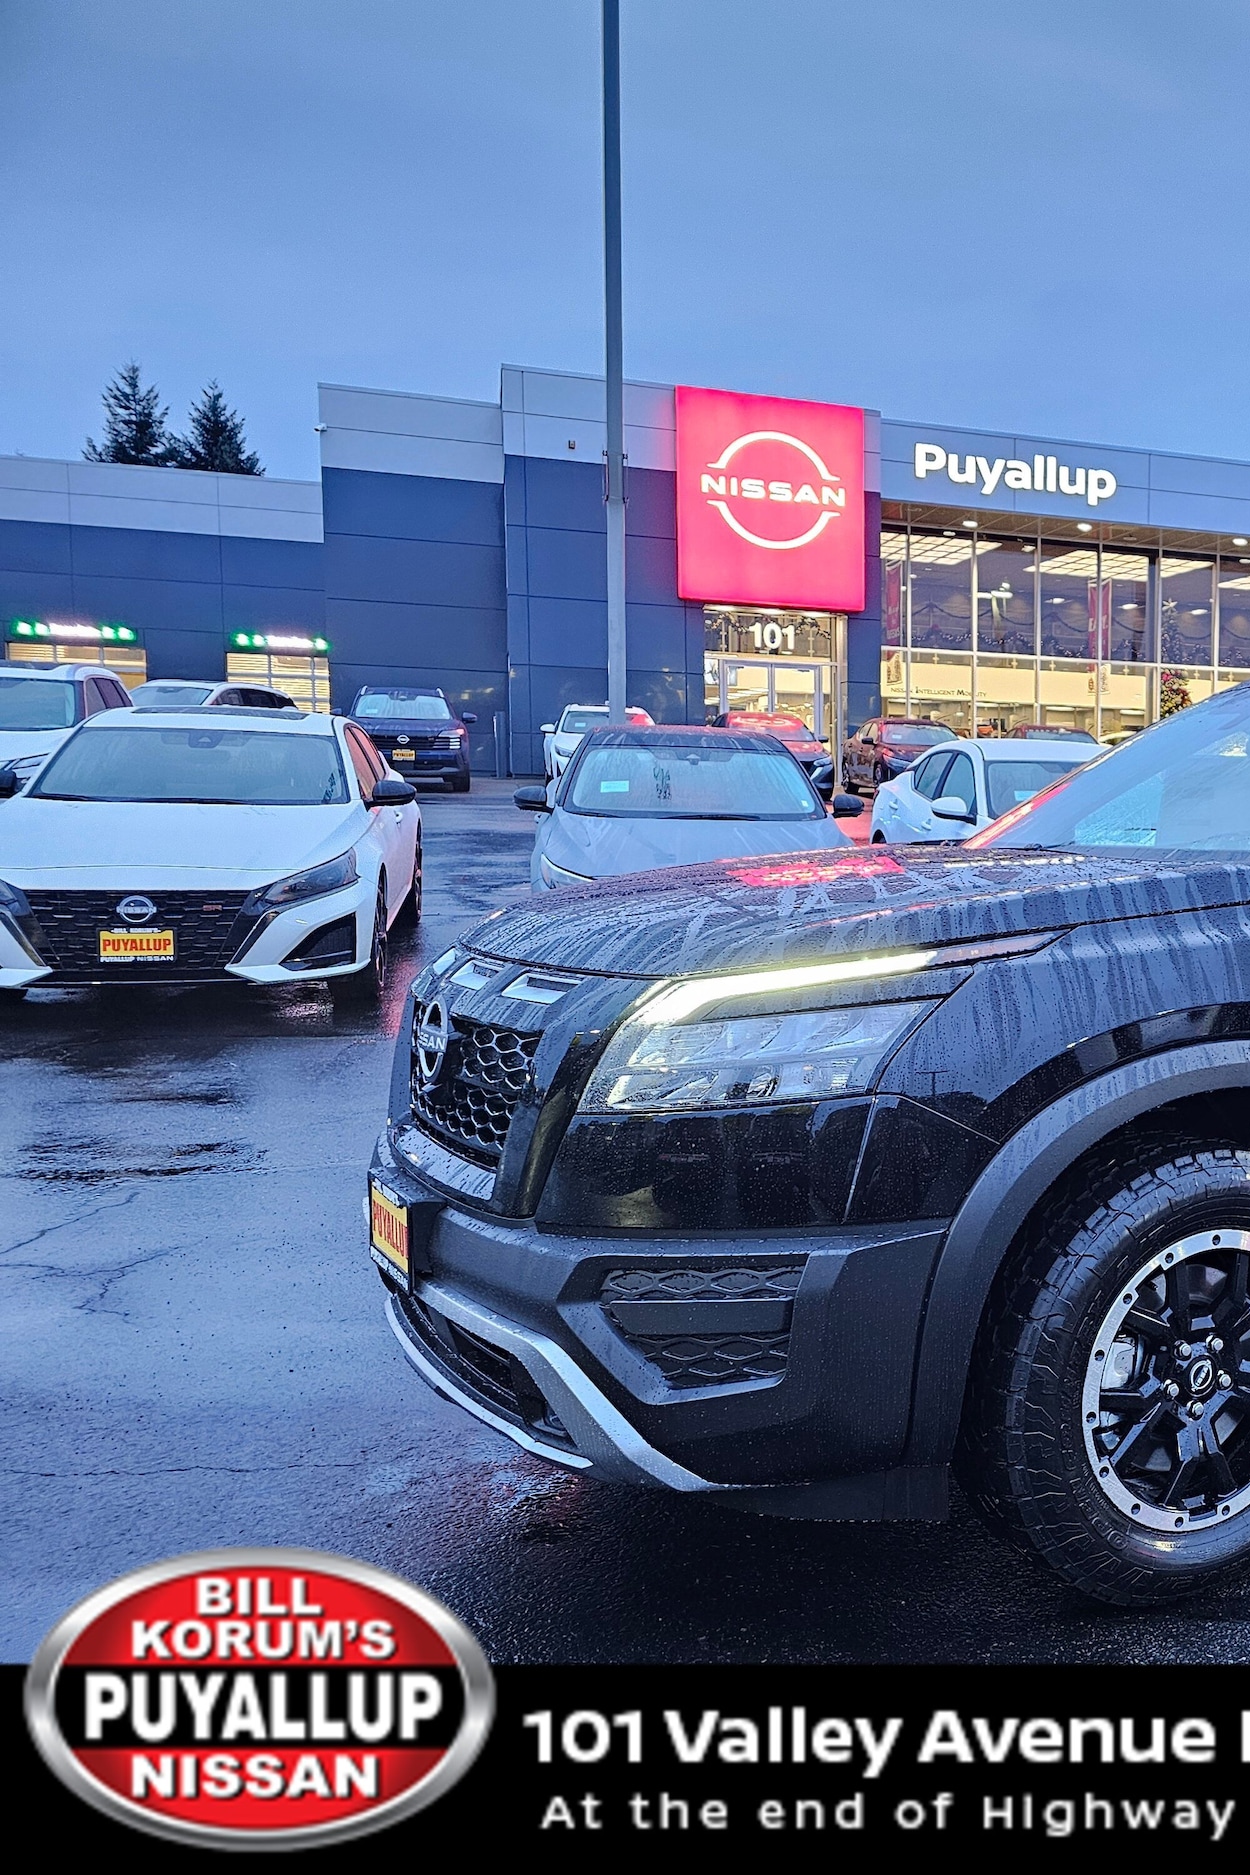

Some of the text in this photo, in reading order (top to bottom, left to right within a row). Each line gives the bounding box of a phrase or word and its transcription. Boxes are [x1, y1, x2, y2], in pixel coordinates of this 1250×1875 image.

[914, 442, 1118, 506] Puyallup
[700, 473, 846, 507] NISSAN
[748, 621, 795, 650] 101
[102, 938, 171, 952] PUYALLUP
